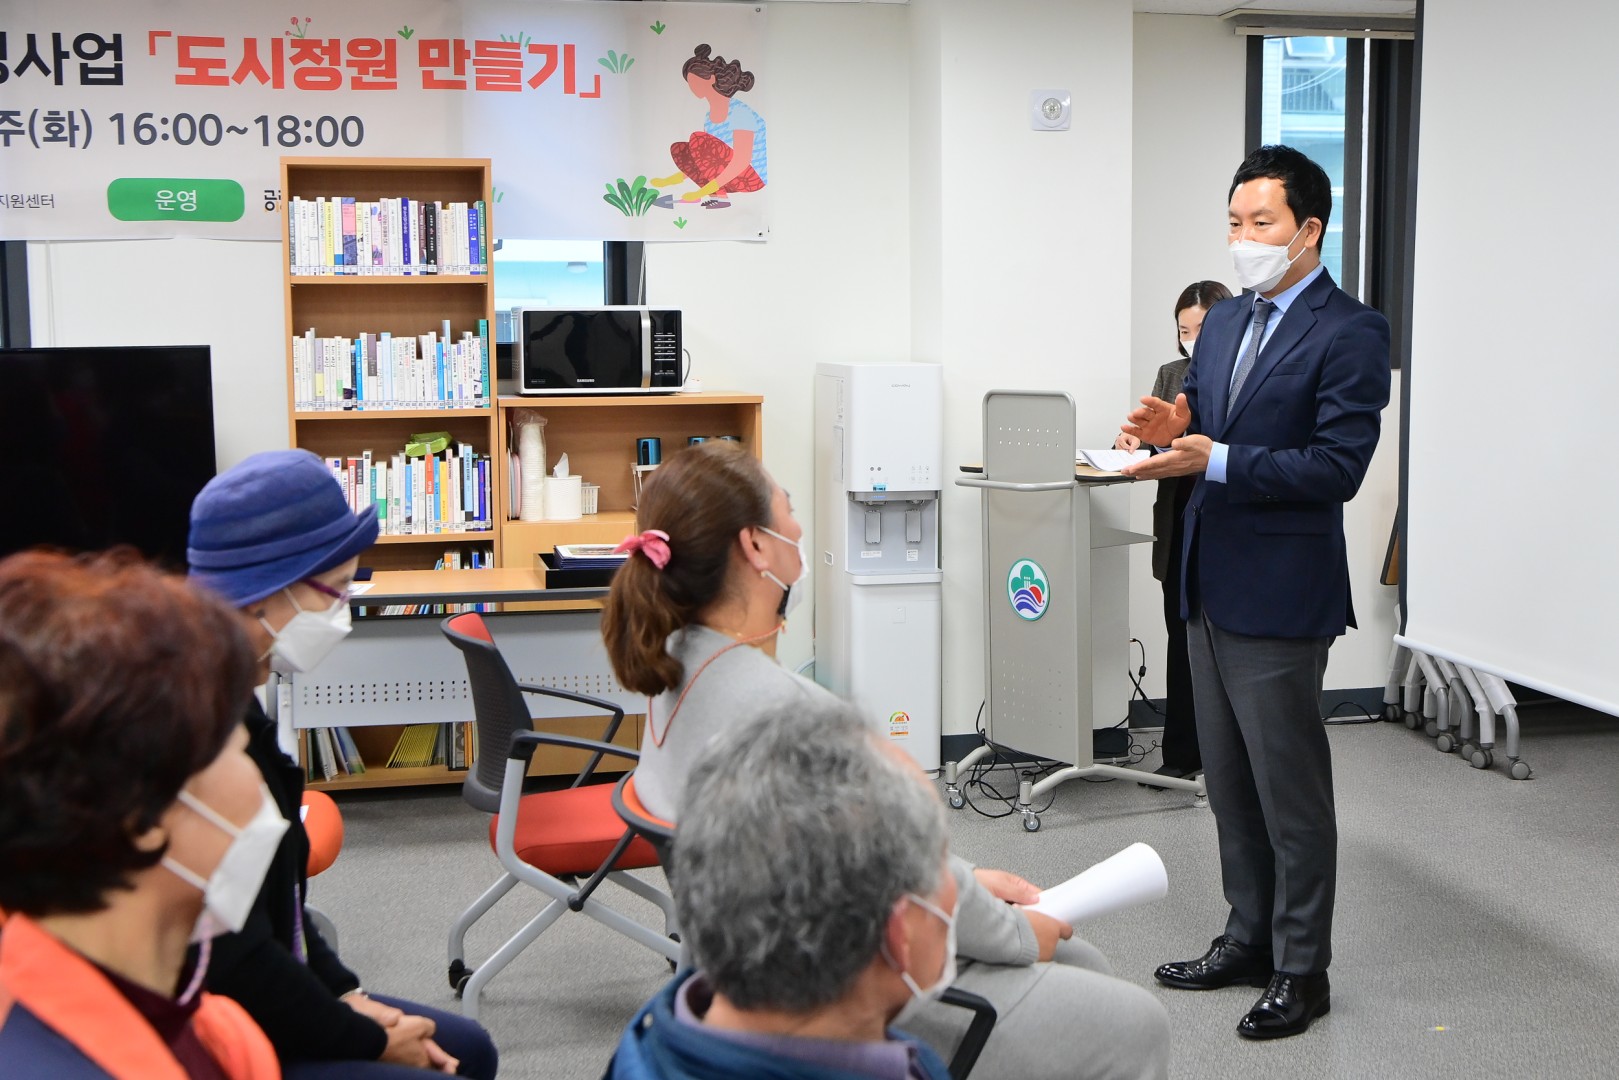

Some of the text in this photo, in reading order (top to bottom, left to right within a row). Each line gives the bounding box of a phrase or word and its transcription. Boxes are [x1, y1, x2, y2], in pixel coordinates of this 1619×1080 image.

[149, 30, 398, 91] 「도시정원
[419, 39, 601, 99] 만들기」
[108, 112, 364, 148] 16:00~18:00
[154, 189, 197, 212] 운영
[263, 189, 281, 212] 공
